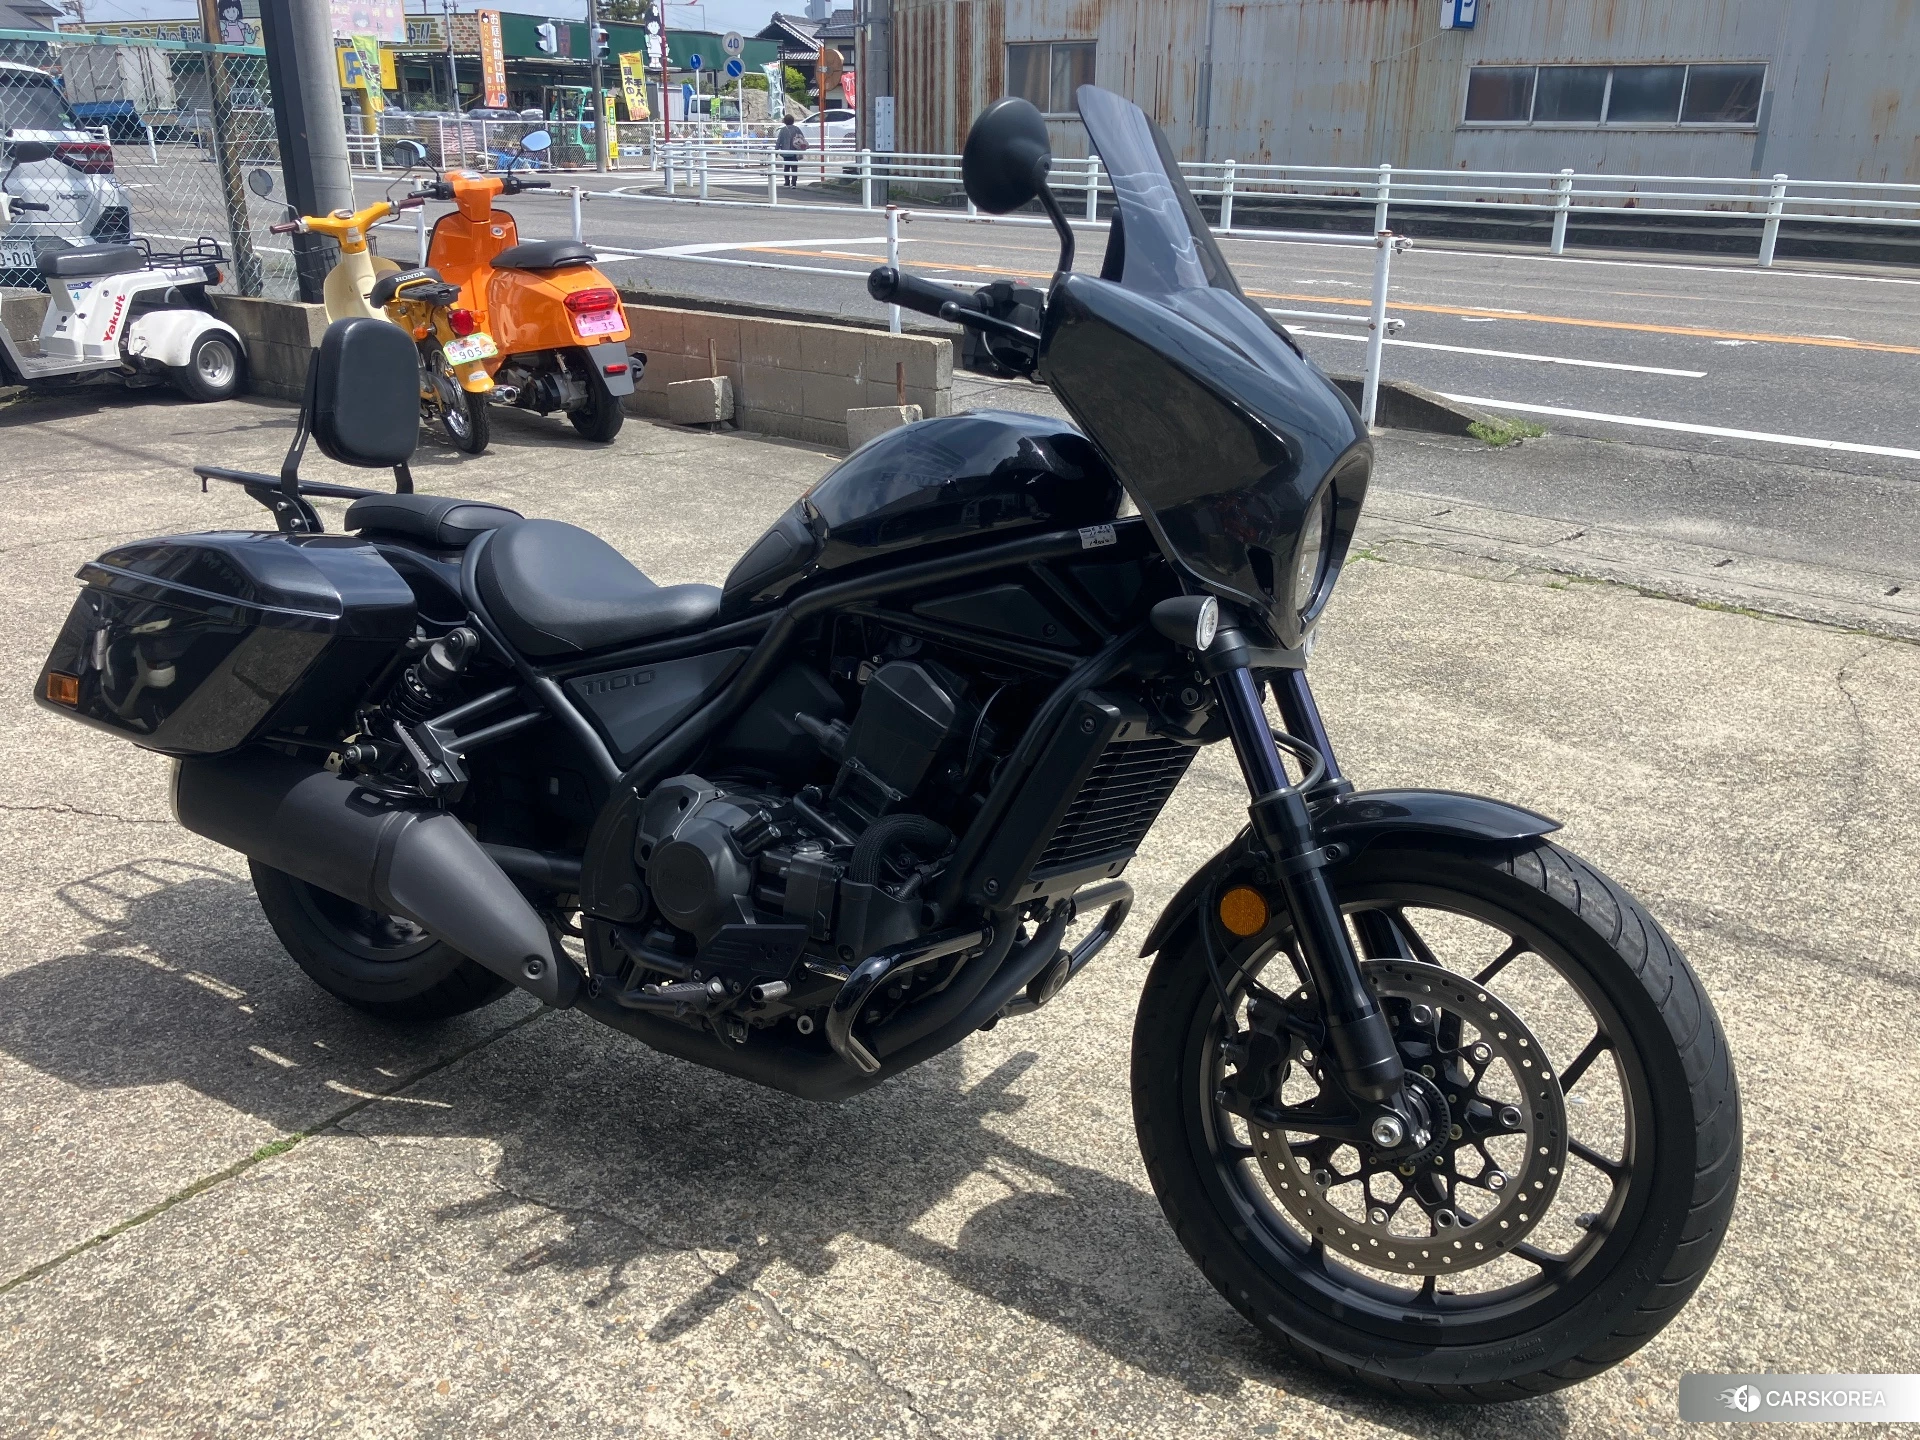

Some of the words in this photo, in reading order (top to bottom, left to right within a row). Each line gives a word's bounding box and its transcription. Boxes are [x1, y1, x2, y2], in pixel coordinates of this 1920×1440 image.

[727, 38, 740, 49] 40
[394, 271, 427, 283] HONDA
[73, 292, 80, 300] 4
[103, 294, 126, 341] Yakult
[458, 346, 483, 360] 905
[582, 669, 656, 695] 1100
